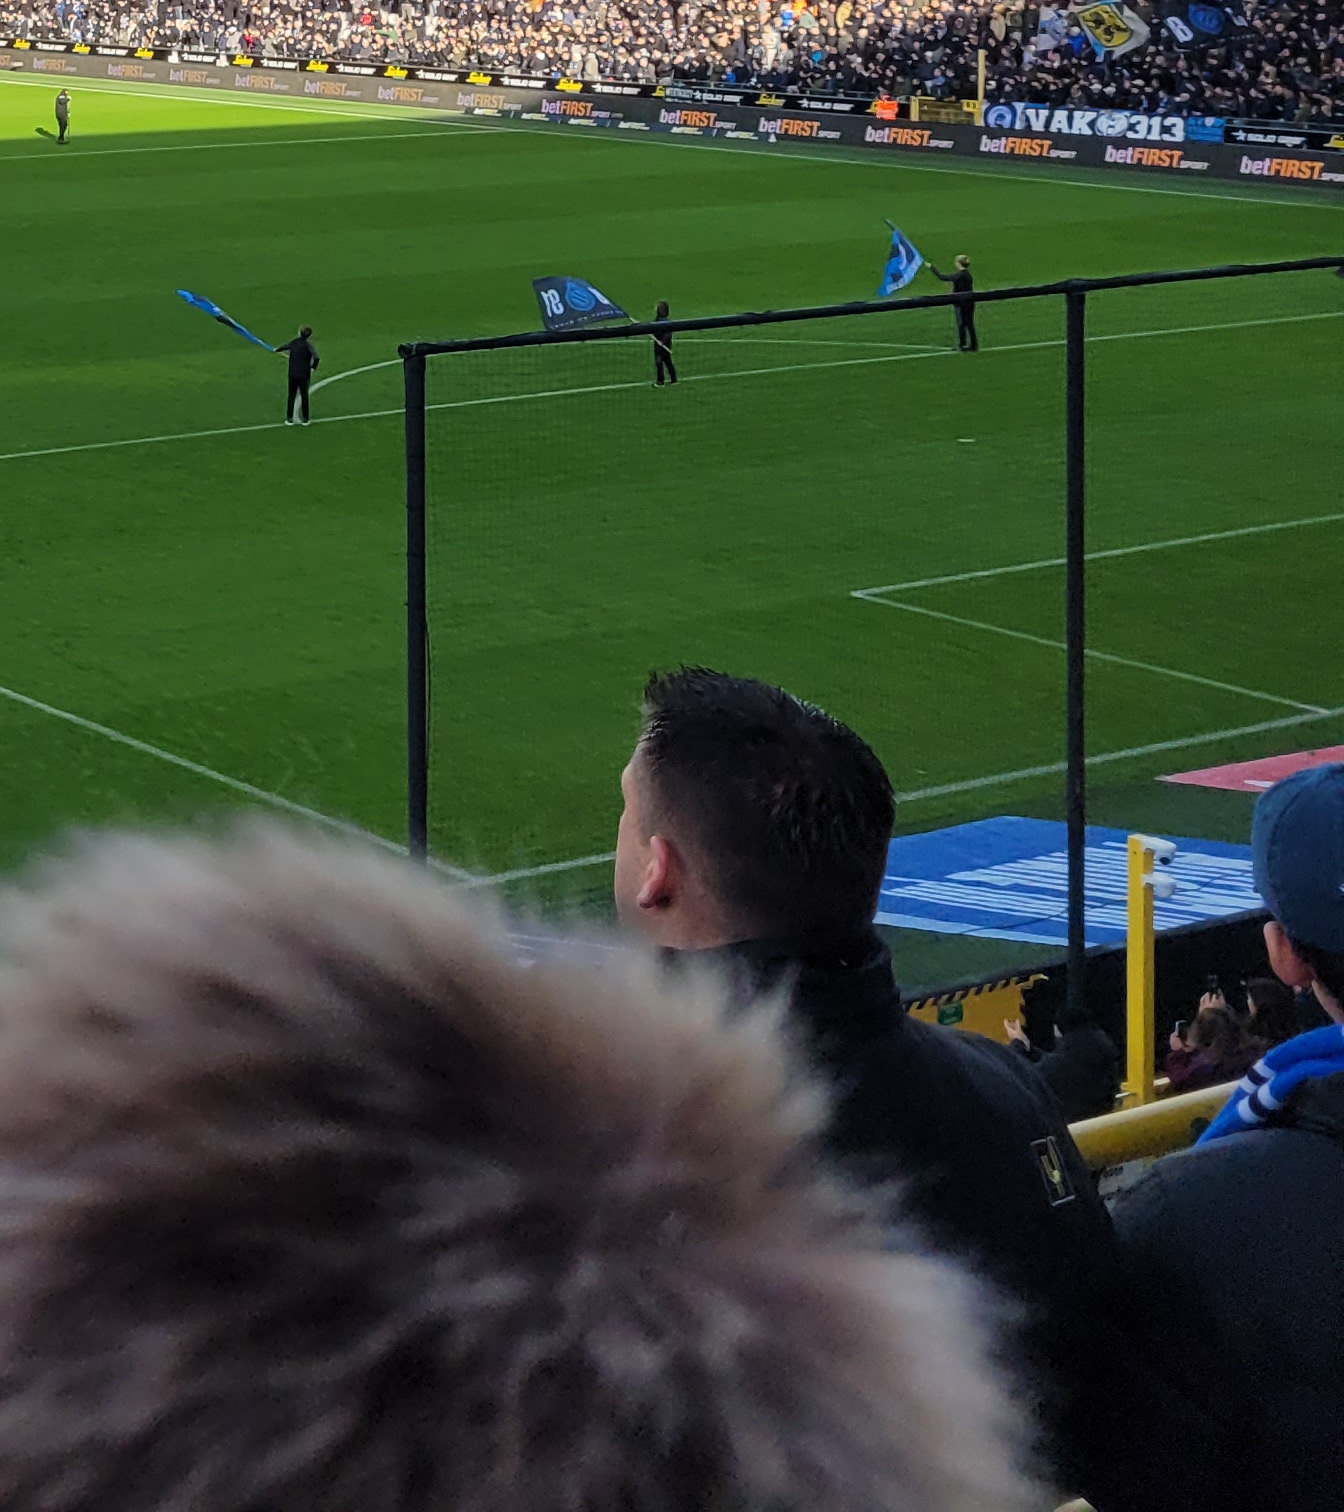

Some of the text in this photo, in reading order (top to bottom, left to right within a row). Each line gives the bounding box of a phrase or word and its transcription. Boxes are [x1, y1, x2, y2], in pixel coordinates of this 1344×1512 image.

[235, 73, 275, 88] betFIRST
[304, 80, 347, 95] betFIRST
[378, 86, 424, 101] betFIRST
[457, 92, 506, 109] betFIRST
[541, 99, 594, 116] betFIRST
[659, 108, 717, 128] betFIRST
[759, 117, 820, 137] betFIRST
[1024, 108, 1185, 142] VAK 313
[864, 125, 932, 147] betFIRST
[979, 134, 1052, 157] betFIRST
[1104, 145, 1184, 169] betFIRST
[1239, 155, 1324, 181] betFIRST
